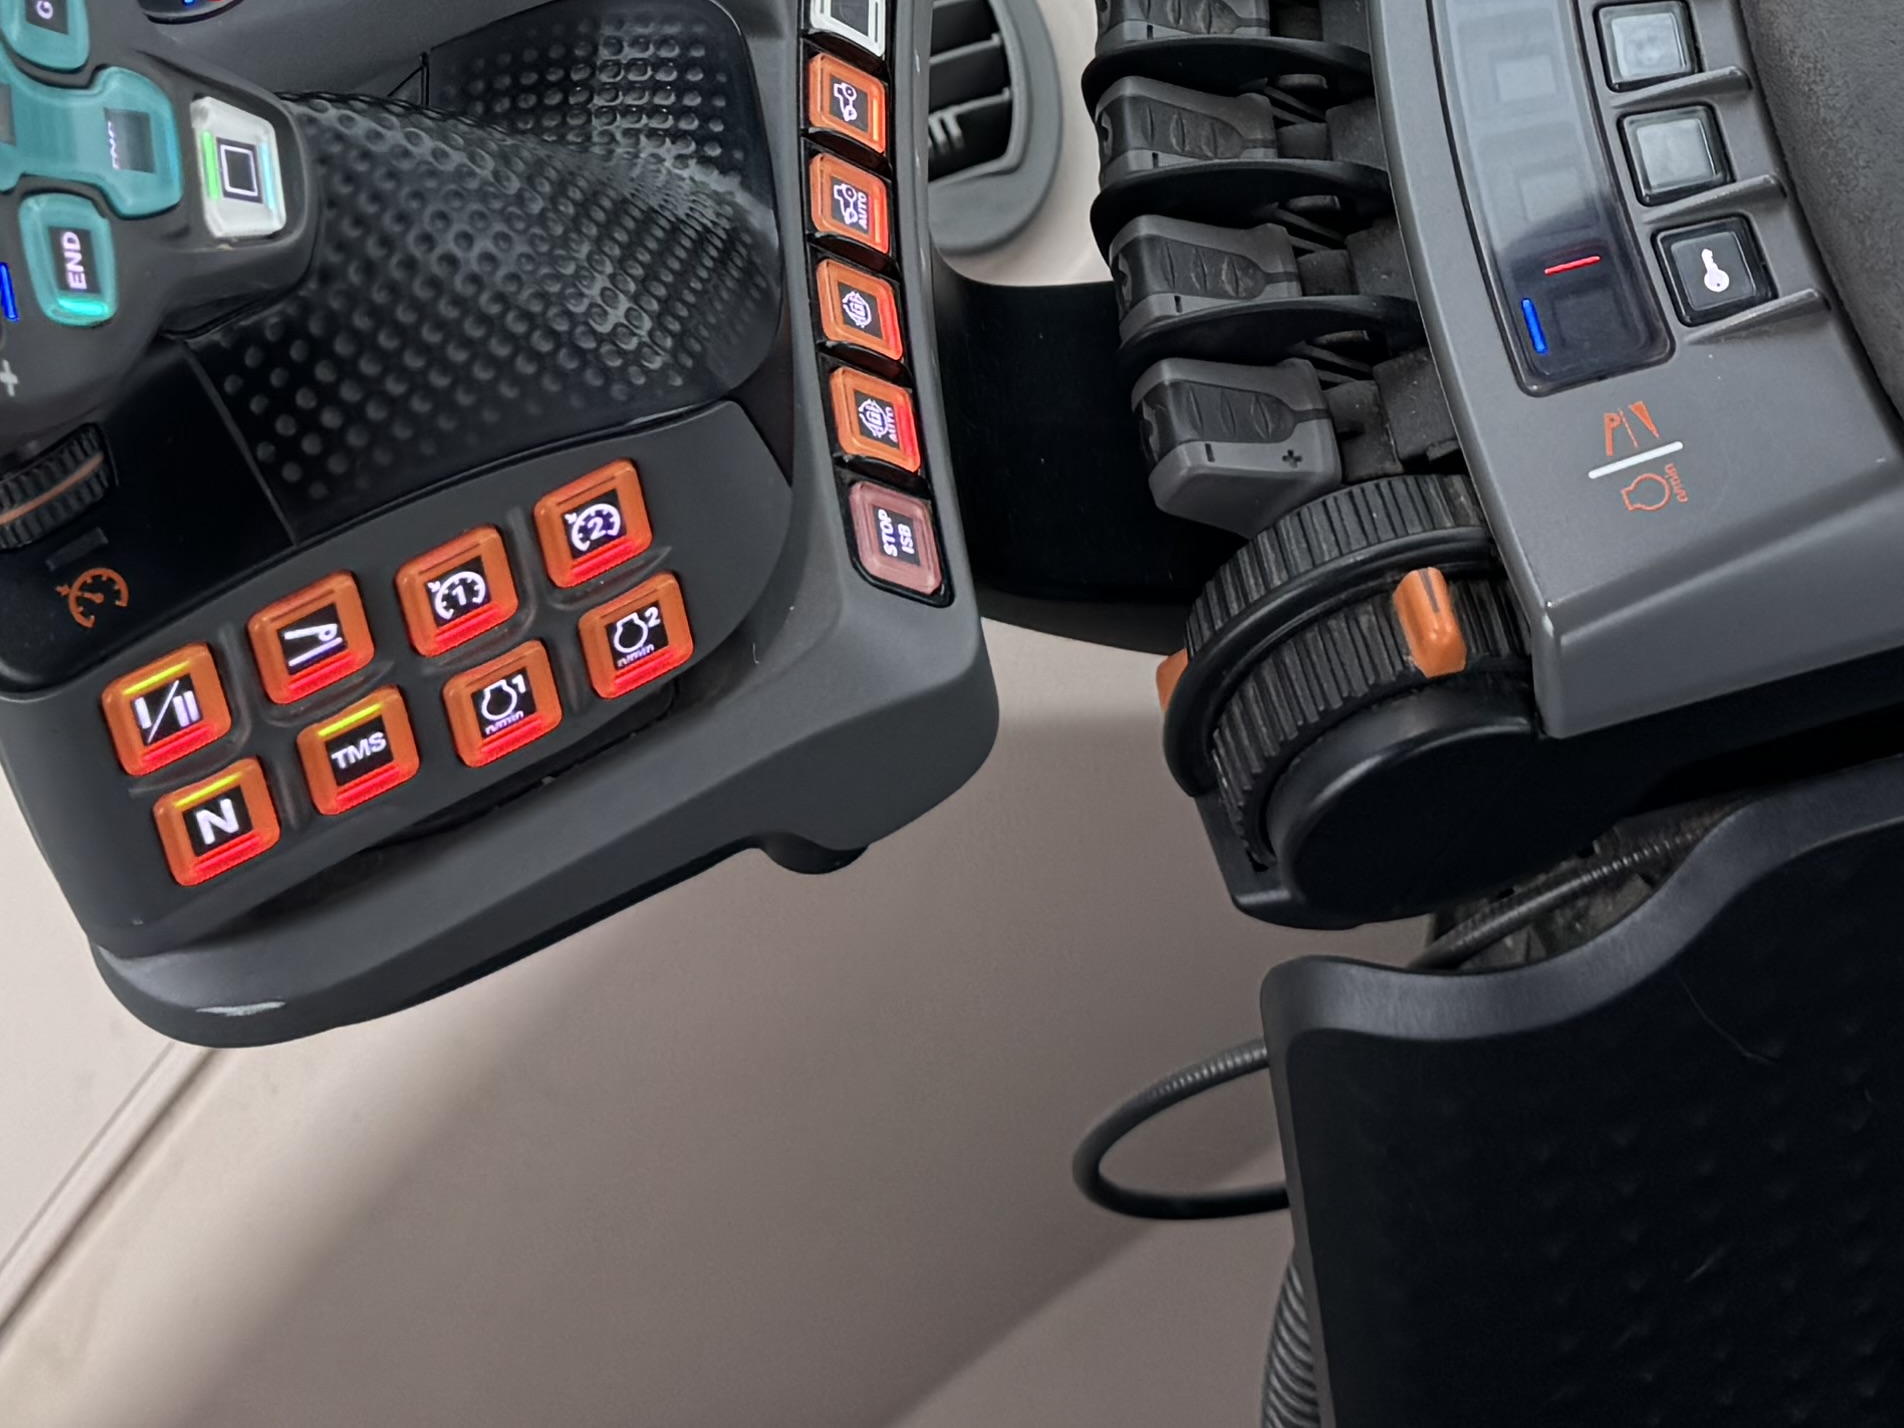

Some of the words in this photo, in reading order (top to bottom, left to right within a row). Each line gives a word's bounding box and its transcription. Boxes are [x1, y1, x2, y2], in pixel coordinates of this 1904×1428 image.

[858, 191, 868, 230] AUTO
[60, 230, 88, 290] END
[588, 516, 606, 541] 2
[878, 508, 898, 558] STOP
[898, 523, 915, 555] ISB
[452, 584, 468, 606] 1
[644, 606, 662, 628] 2
[512, 674, 527, 694] 1
[330, 731, 388, 770] TMS
[195, 798, 240, 846] N
